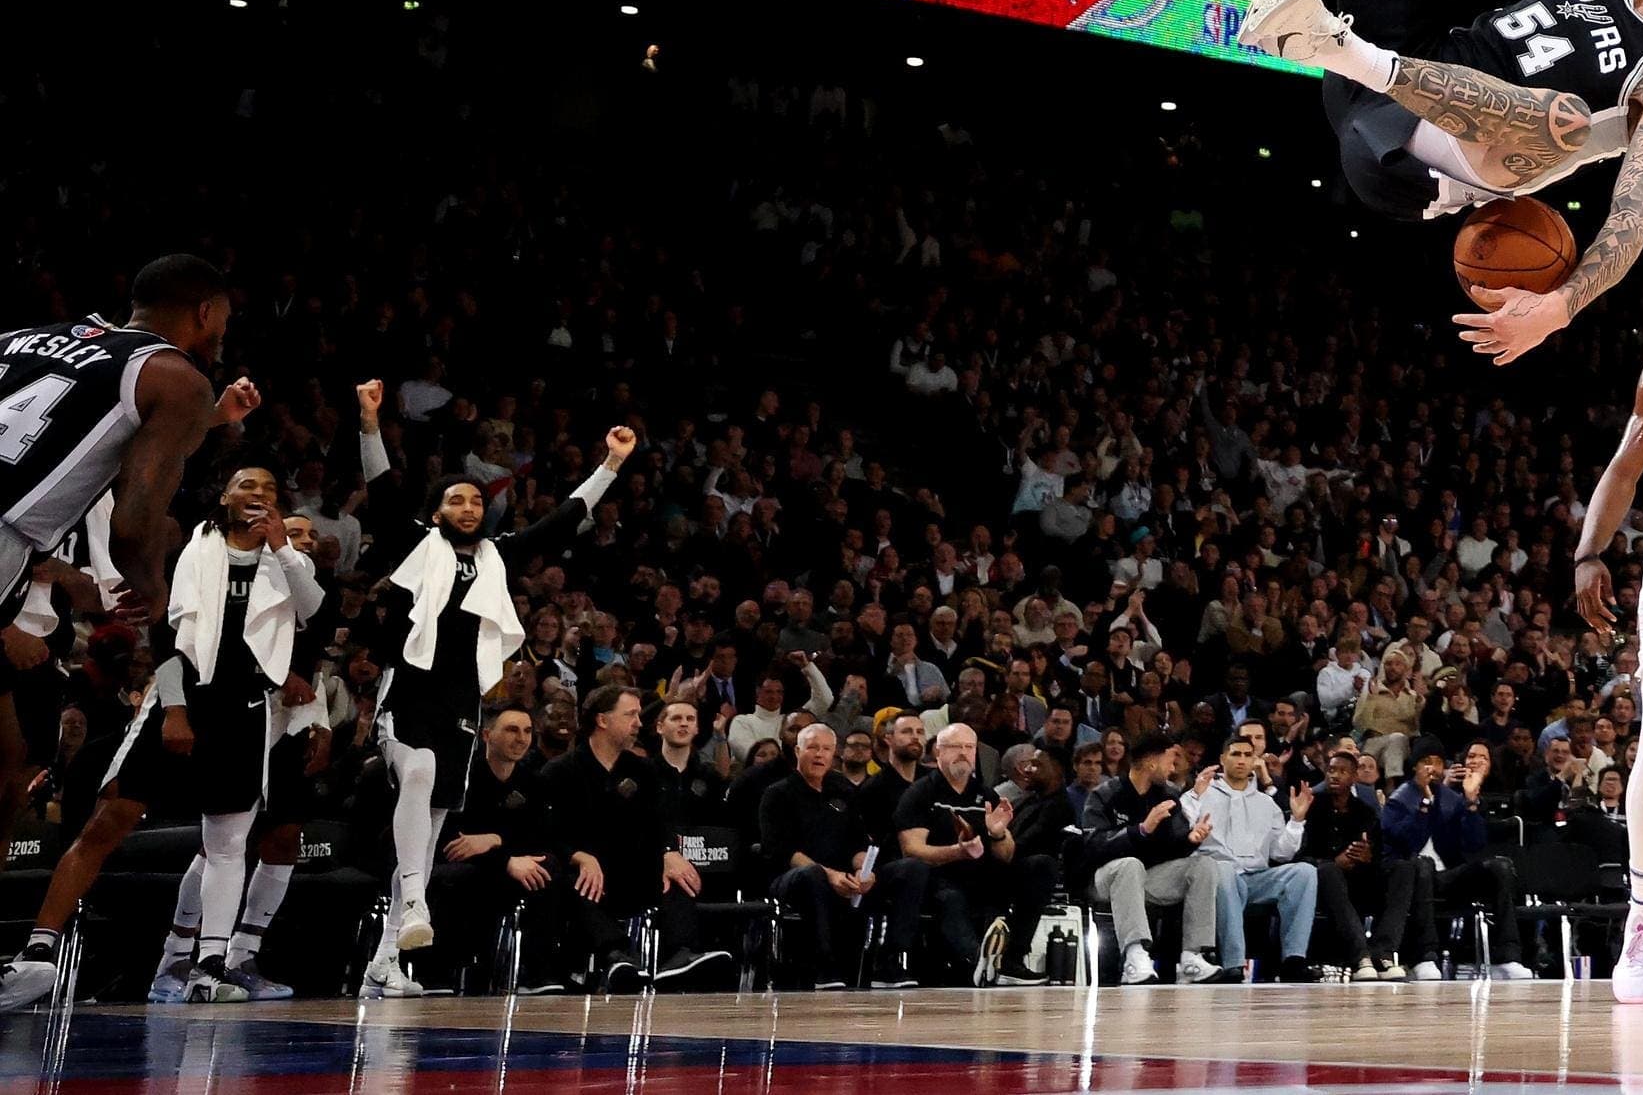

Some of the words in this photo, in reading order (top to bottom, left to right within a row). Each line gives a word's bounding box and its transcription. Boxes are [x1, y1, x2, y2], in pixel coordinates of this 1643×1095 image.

[1493, 0, 1576, 78] 54
[4, 333, 113, 369] WESLEY
[0, 363, 77, 465] 4
[14, 840, 41, 855] 2025
[307, 842, 332, 857] 2025
[707, 847, 728, 861] 2025
